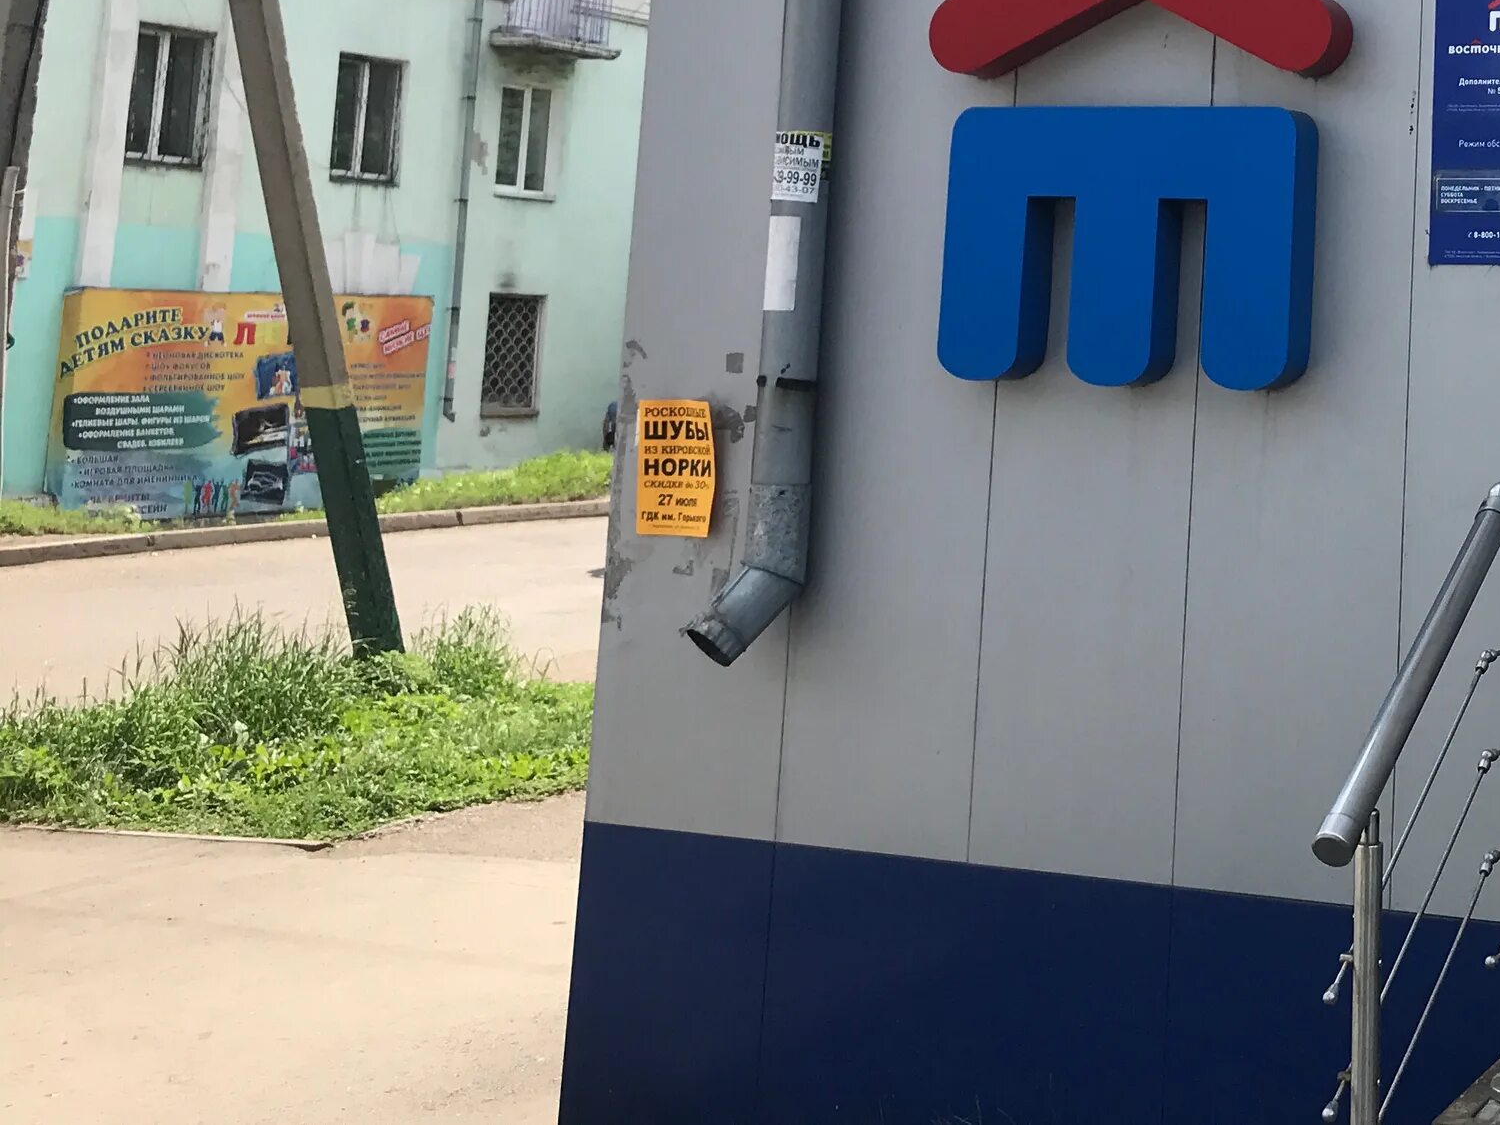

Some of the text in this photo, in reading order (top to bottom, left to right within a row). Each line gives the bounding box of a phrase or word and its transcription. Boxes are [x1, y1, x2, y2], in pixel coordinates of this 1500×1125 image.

[1458, 139, 1486, 148] Режим
[74, 307, 182, 350] ПОДАРИТЕ
[60, 325, 210, 380] ДЕТЯМ СКАЗКУ
[644, 420, 709, 442] ШУБЫ
[643, 458, 712, 478] НОРКИ
[658, 493, 674, 507] 27
[641, 510, 660, 522] ГДК
